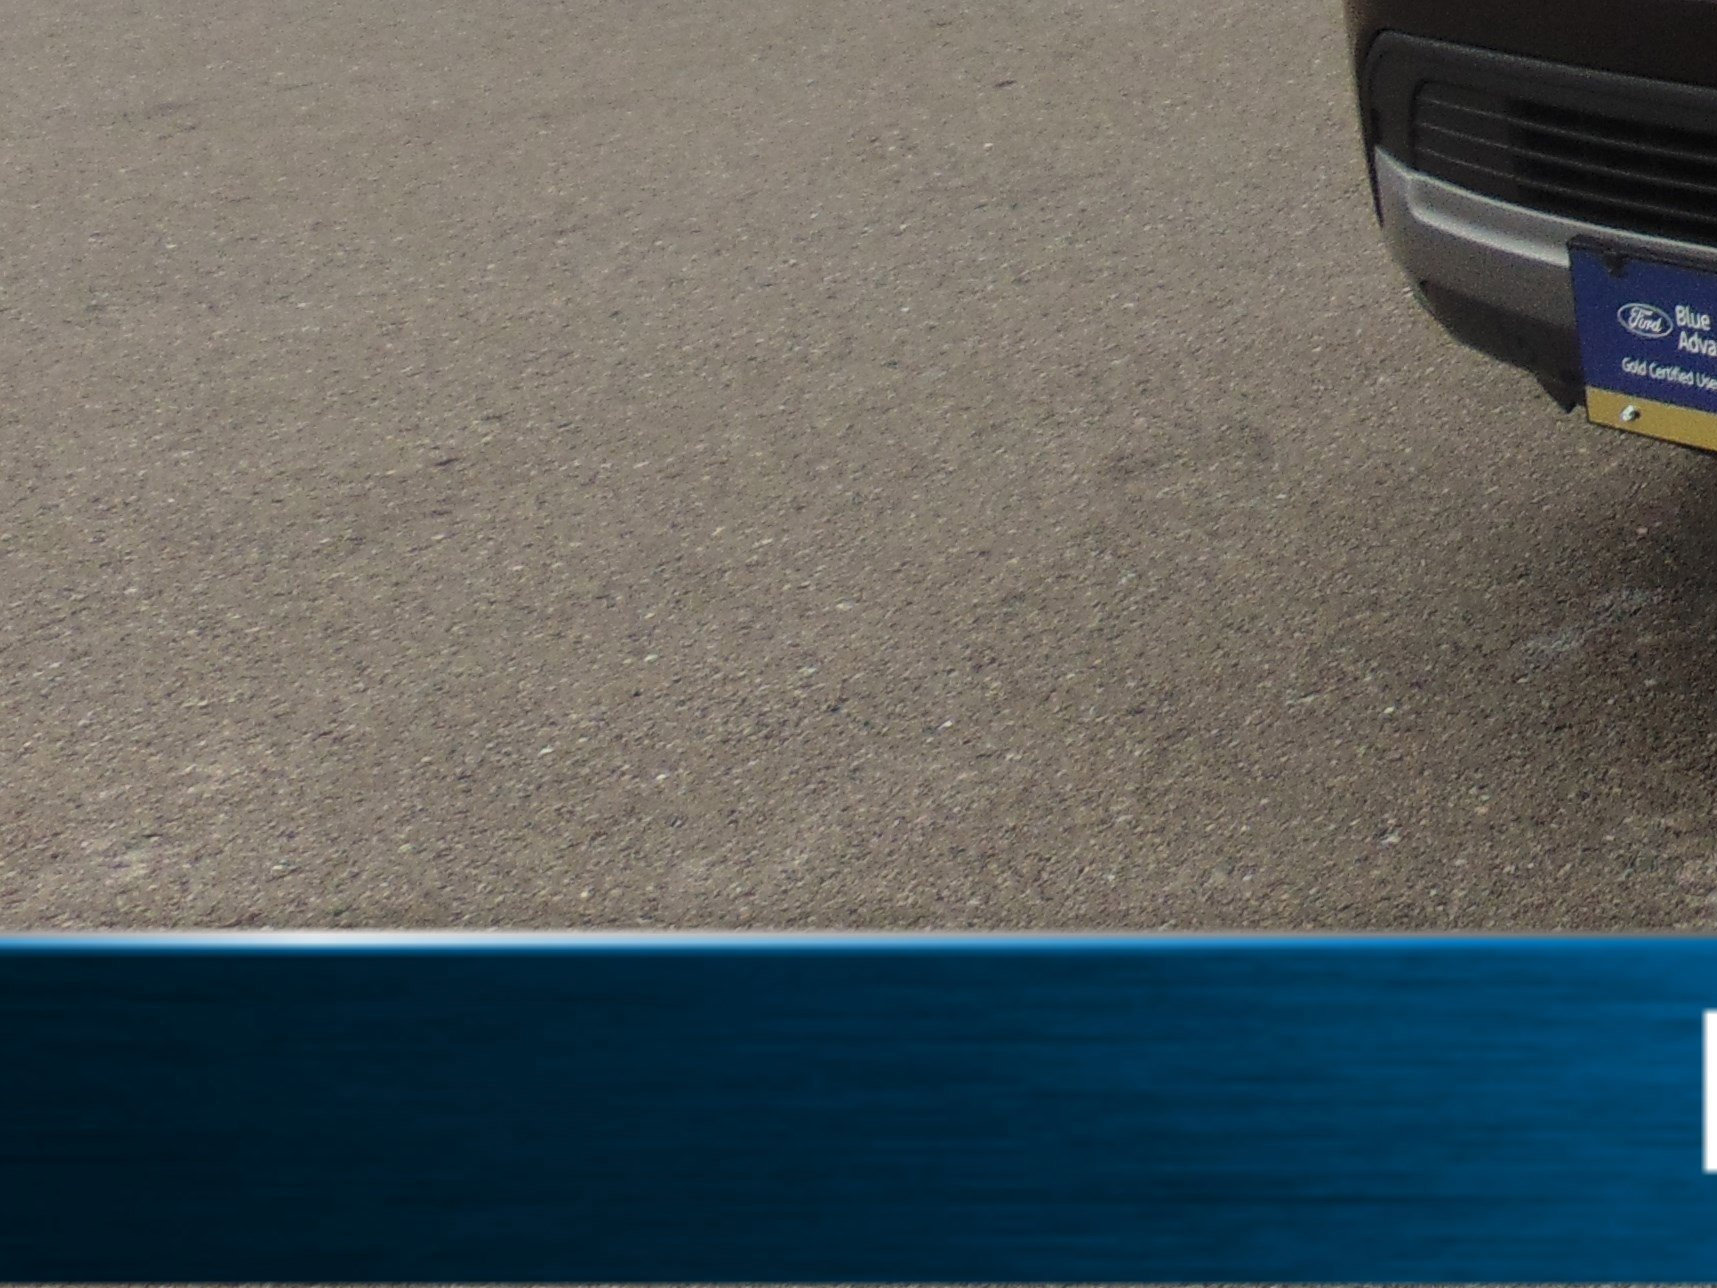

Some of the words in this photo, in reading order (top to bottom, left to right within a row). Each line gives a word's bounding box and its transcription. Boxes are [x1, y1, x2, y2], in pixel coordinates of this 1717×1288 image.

[1627, 305, 1664, 333] Ford
[1675, 305, 1711, 331] Blue
[1621, 356, 1647, 376] Gold
[1649, 361, 1694, 386] Certified
